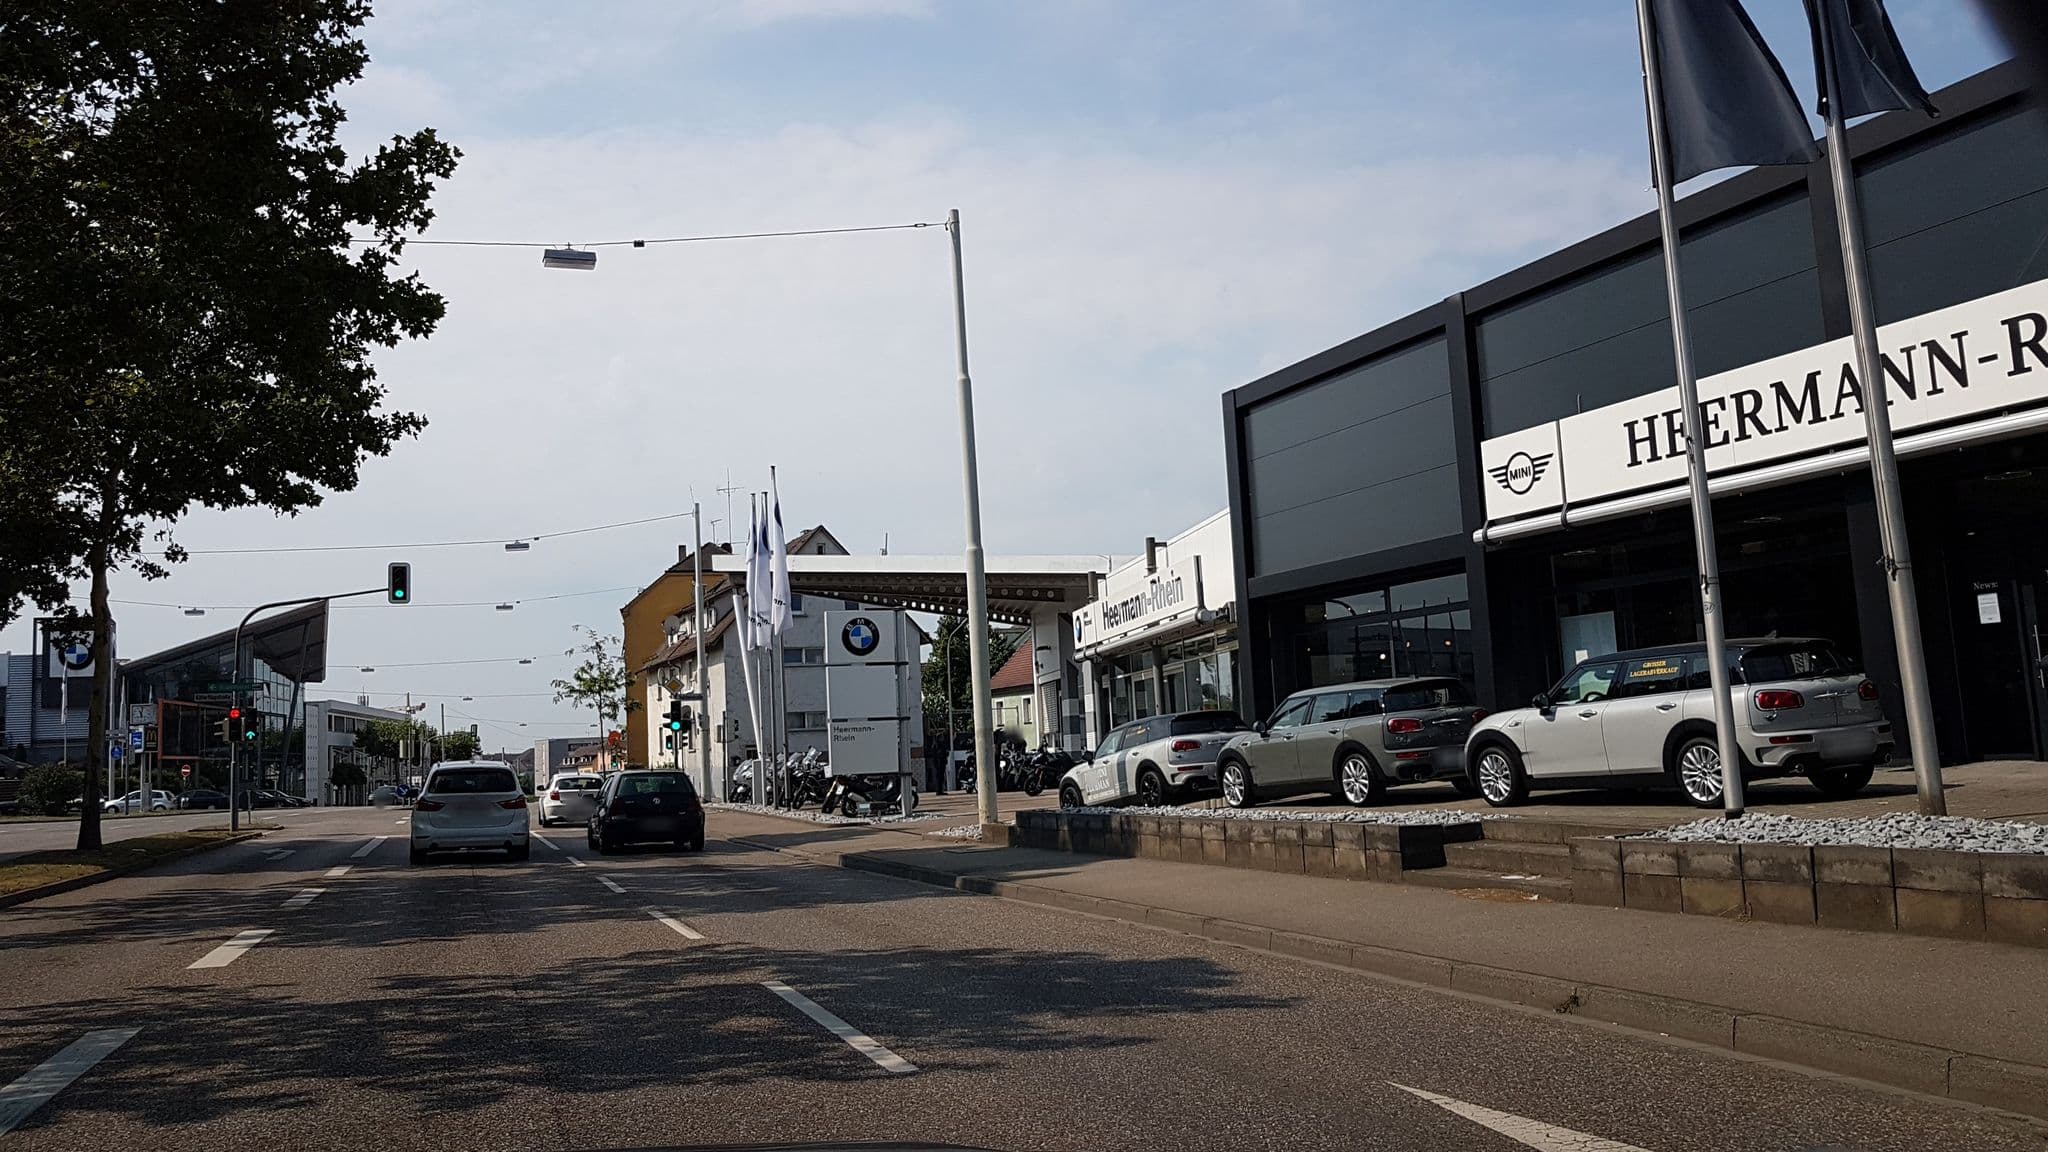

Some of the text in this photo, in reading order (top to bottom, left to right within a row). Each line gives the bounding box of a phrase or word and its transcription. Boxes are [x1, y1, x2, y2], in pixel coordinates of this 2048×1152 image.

[1509, 465, 1531, 481] MINI
[1102, 570, 1184, 630] Heermann-Rhein
[833, 734, 856, 742] Rhein
